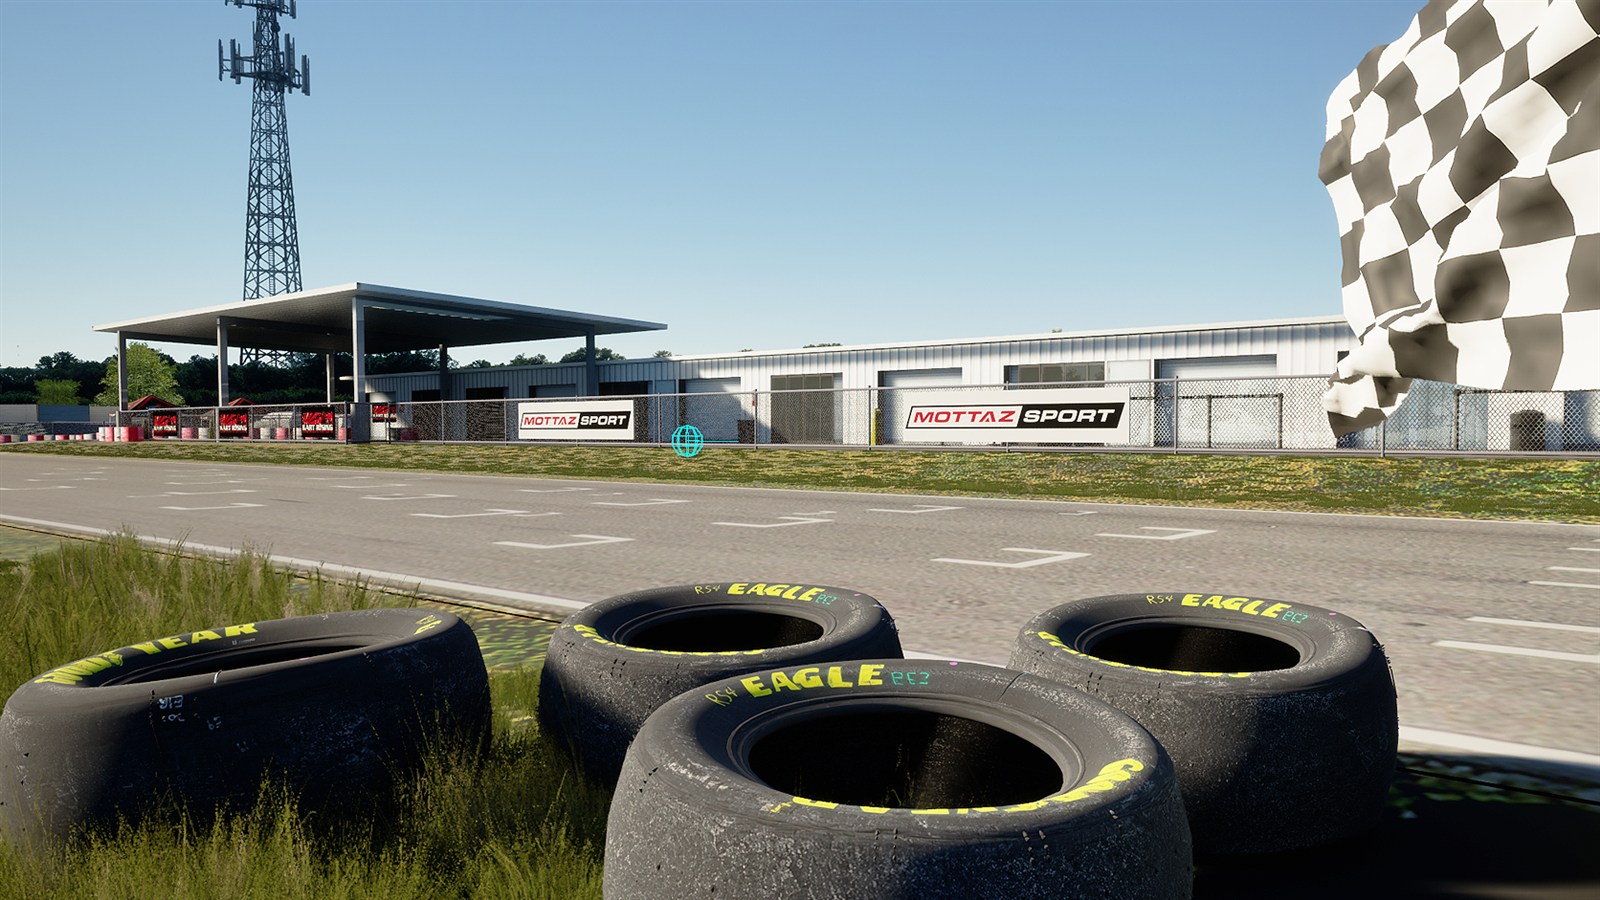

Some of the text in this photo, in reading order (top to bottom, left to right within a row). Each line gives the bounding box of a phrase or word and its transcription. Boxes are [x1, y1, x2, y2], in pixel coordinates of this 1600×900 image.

[523, 415, 626, 426] MOTTAZ SPORT
[914, 409, 1115, 423] MOTTAZ SPORT
[727, 583, 825, 602] EAGLE
[1181, 594, 1292, 618] EAGLE
[131, 623, 258, 655] YEAR
[740, 664, 885, 698] EAGLE
